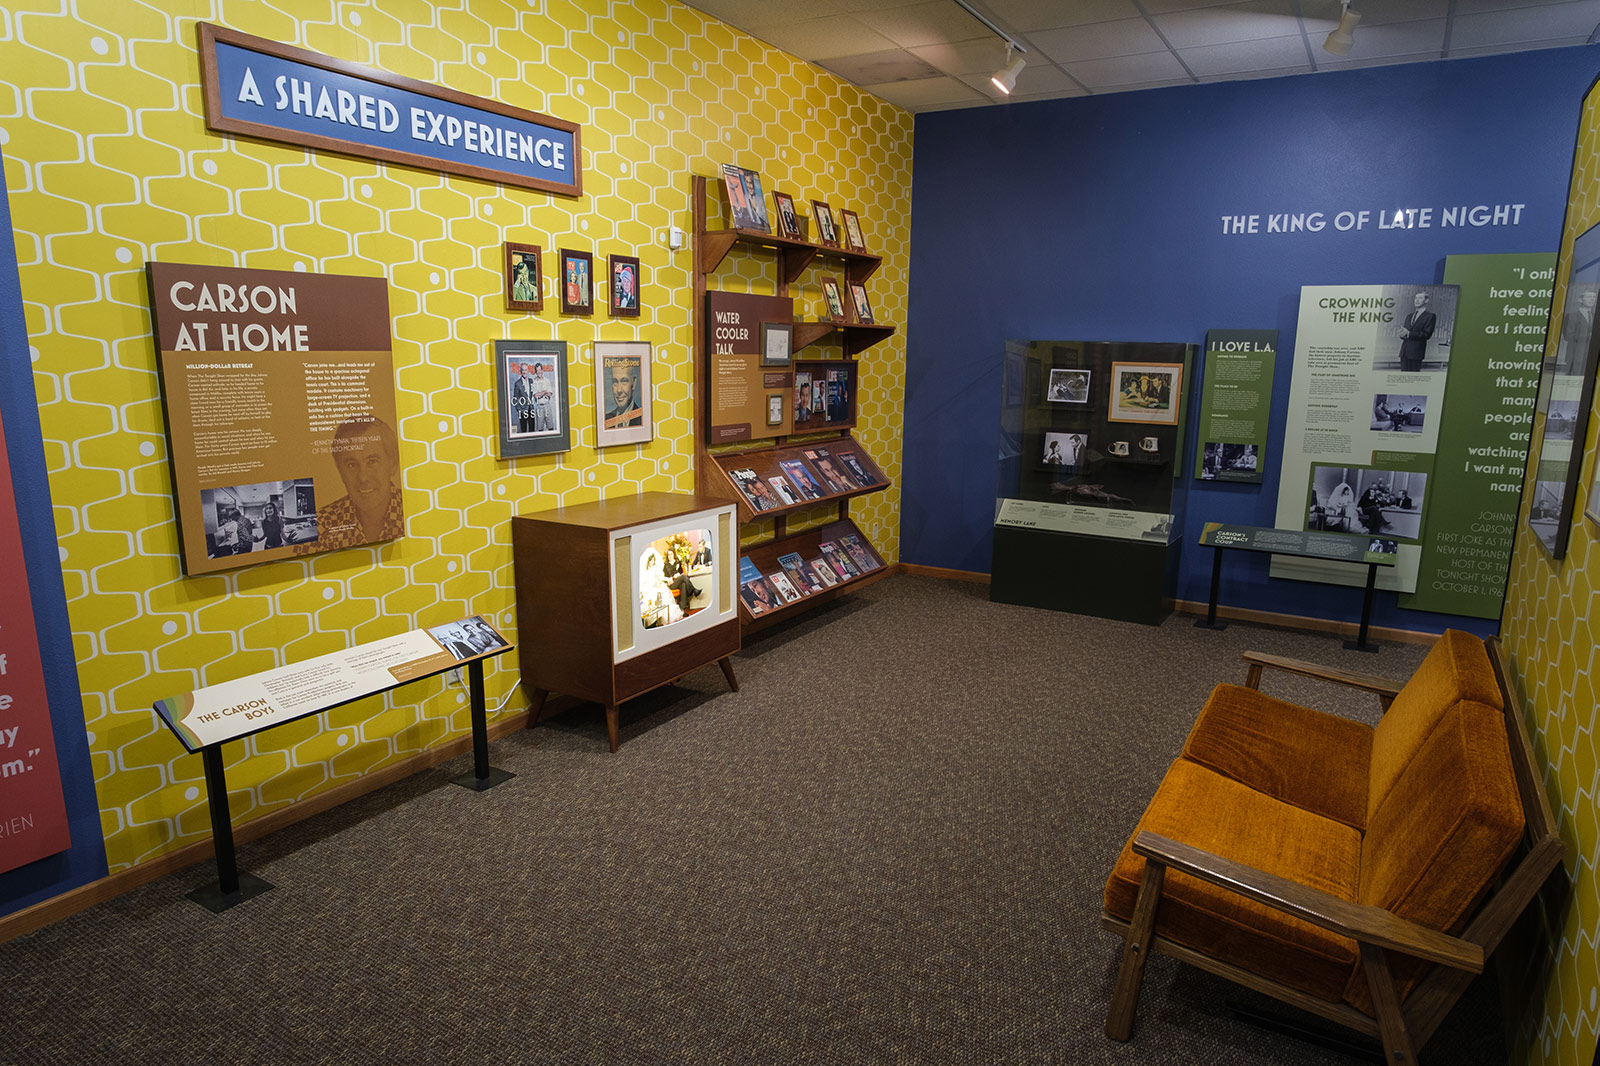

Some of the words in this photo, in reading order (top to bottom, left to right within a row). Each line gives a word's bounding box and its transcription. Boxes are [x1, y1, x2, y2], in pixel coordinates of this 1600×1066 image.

[237, 66, 265, 107] A
[274, 75, 400, 133] SHARED
[410, 107, 566, 171] EXPERIENCE
[1221, 214, 1260, 235] THE
[1267, 211, 1327, 234] KING
[1334, 210, 1370, 232] OF
[1378, 208, 1433, 230] LATE
[1441, 203, 1526, 228] NIGHT
[169, 280, 298, 316] CARSON
[1490, 286, 1524, 298] have
[1528, 288, 1553, 298] one
[1318, 297, 1396, 309] CROWNING
[715, 311, 741, 325] WATER
[1332, 311, 1355, 323] THE
[1359, 311, 1394, 323] KING
[715, 327, 750, 341] COOLER
[1485, 325, 1500, 335] as
[1504, 322, 1509, 334] I
[174, 321, 209, 352] AT
[220, 323, 310, 353] HOME
[715, 342, 735, 356] TALK
[1211, 341, 1217, 352] I
[1219, 341, 1251, 352] LOVE
[1253, 341, 1276, 353] L.A.
[1514, 340, 1545, 353] here
[1487, 358, 1542, 374] knowing
[1495, 376, 1524, 388] that
[1502, 396, 1536, 409] many
[1484, 412, 1533, 426] people
[1509, 432, 1531, 442] are
[1468, 446, 1528, 461] watching
[1464, 461, 1470, 473] I
[1473, 464, 1505, 475] want
[1436, 532, 1459, 543] FIRST
[1459, 534, 1484, 545] JOKE
[1485, 537, 1497, 547] AS
[1500, 537, 1513, 548] TH
[1436, 544, 1458, 555] NEW
[1459, 546, 1510, 560] PERMANEN
[1451, 558, 1476, 569] HOST
[1477, 561, 1493, 571] OF
[1495, 562, 1509, 573] TH
[1436, 568, 1480, 581] TONIGHT
[1432, 580, 1479, 594] OCTOBER
[1489, 587, 1504, 597] 196
[197, 711, 221, 724] THE
[222, 697, 268, 717] CARSON
[245, 706, 275, 721] BOYS
